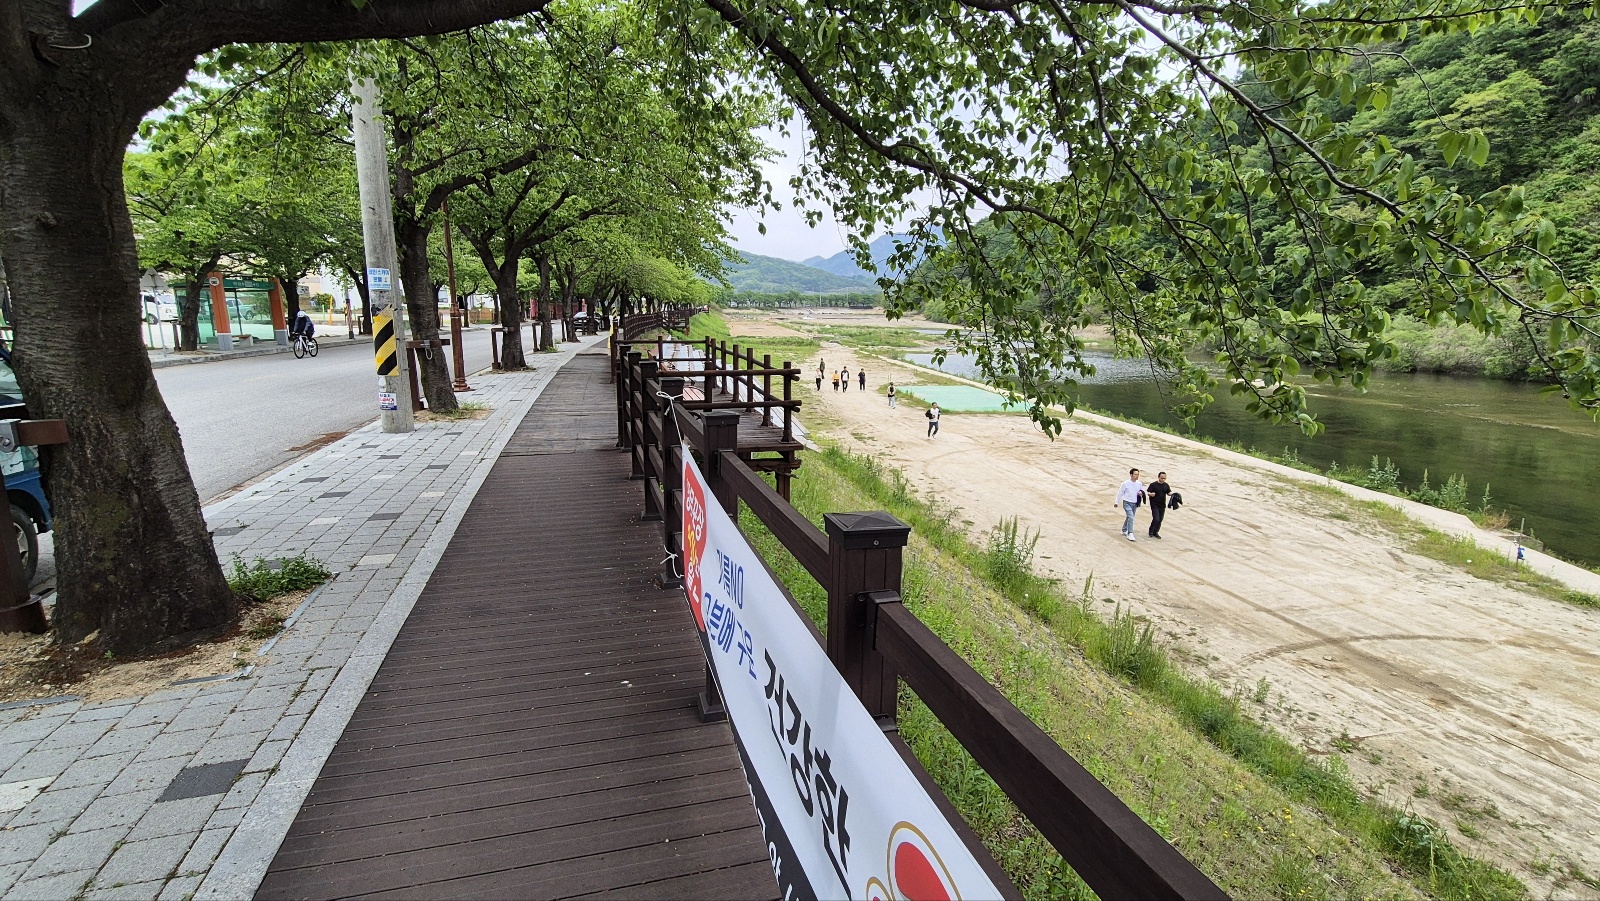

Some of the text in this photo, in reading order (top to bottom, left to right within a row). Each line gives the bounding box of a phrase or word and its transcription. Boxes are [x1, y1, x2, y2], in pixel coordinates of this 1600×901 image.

[716, 548, 744, 610] 기름NO
[736, 618, 758, 681] 구운
[763, 646, 851, 901] 건강한
